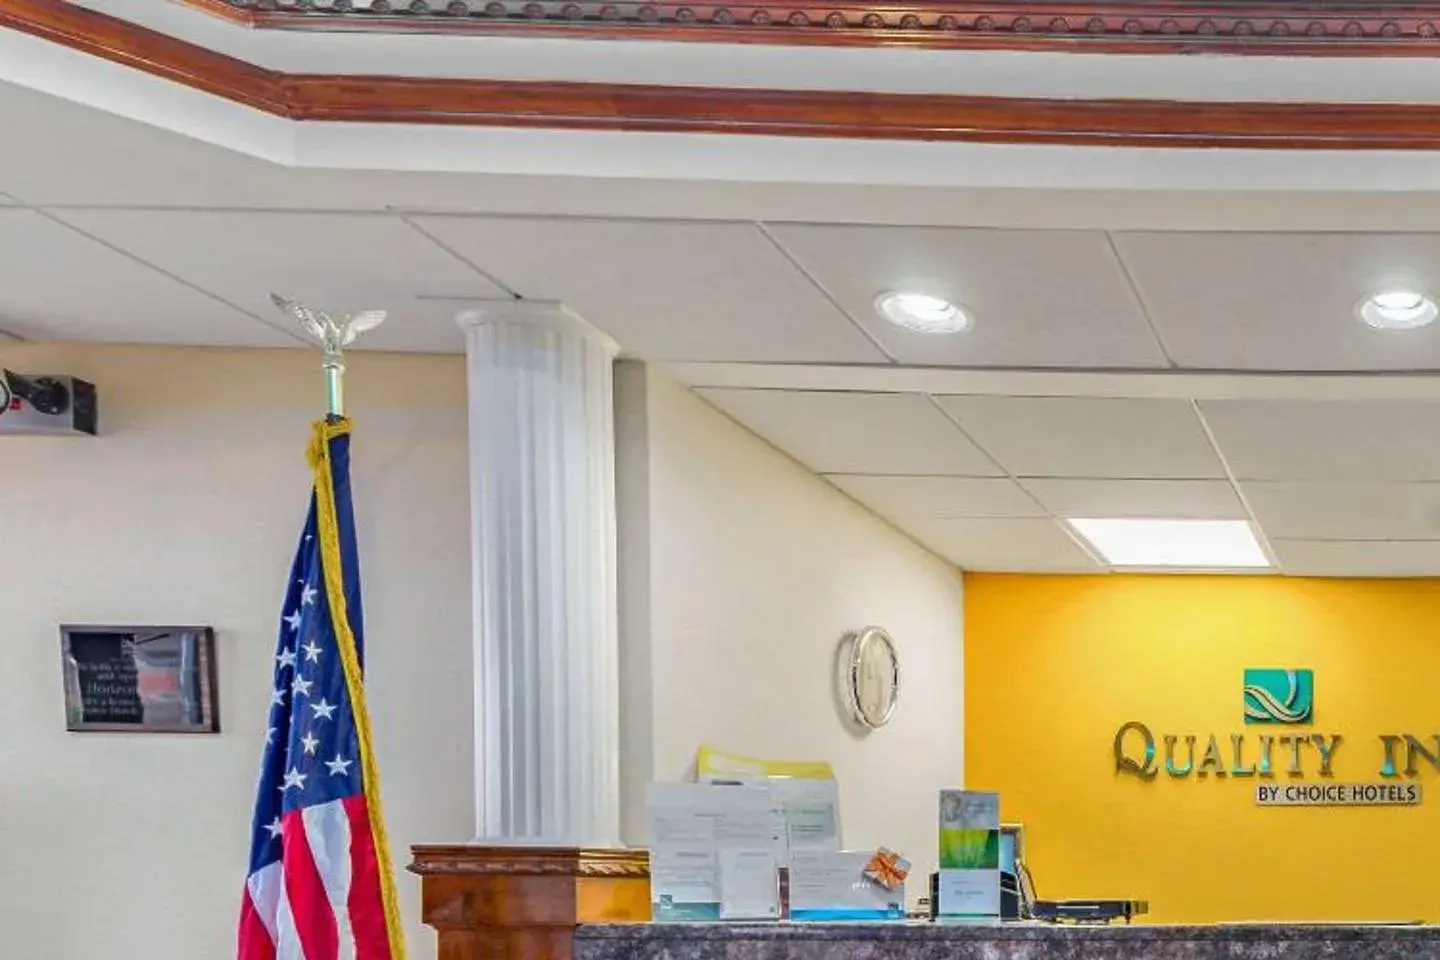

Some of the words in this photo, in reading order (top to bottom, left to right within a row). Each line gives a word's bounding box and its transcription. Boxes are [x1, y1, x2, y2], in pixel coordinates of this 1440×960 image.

[1113, 721, 1342, 780] QUALITY
[1259, 786, 1278, 801] BY
[1286, 786, 1346, 801] CHOICE
[1353, 785, 1416, 801] HOTELS
